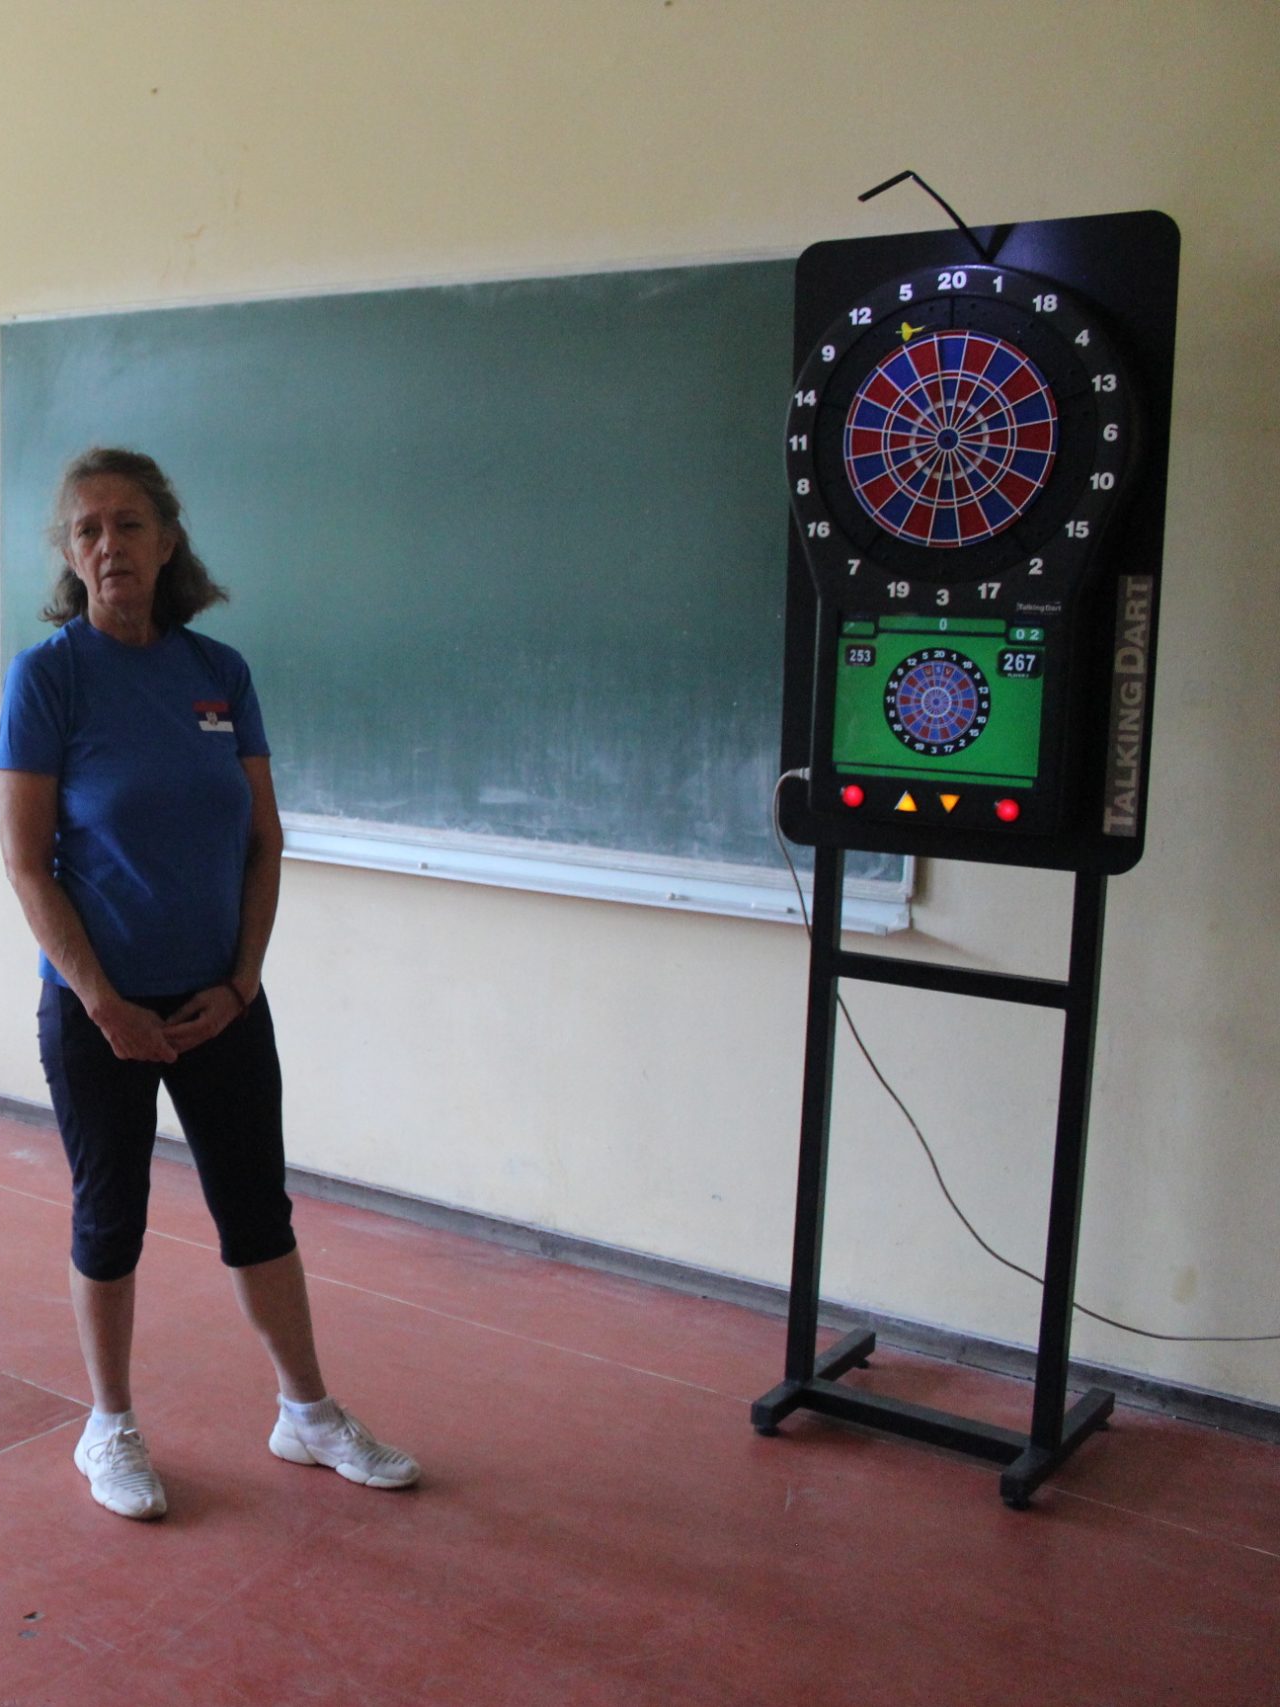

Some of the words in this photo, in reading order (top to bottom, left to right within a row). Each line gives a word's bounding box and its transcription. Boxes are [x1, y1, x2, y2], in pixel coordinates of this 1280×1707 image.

[938, 271, 967, 290] 20
[993, 275, 1003, 293] 1
[899, 283, 912, 301] 5
[1032, 294, 1057, 313] 18
[849, 307, 872, 325] 12
[1074, 329, 1090, 346] 4
[821, 345, 835, 362] 9
[1091, 374, 1117, 392] 13
[794, 390, 817, 407] 14
[1103, 424, 1118, 442] 6
[789, 435, 808, 451] 11
[797, 478, 810, 495] 8
[1090, 472, 1114, 490] 10
[807, 521, 830, 538] 16
[1065, 520, 1089, 538] 15
[848, 559, 861, 575] 7
[1028, 558, 1043, 575] 2
[887, 581, 910, 598] 19
[936, 588, 950, 606] 3
[977, 582, 1001, 599] 17
[939, 618, 947, 631] 0
[1114, 577, 1148, 674] DART
[850, 649, 871, 662] 253
[1003, 653, 1036, 672] 267
[1103, 681, 1143, 835] TALKING
